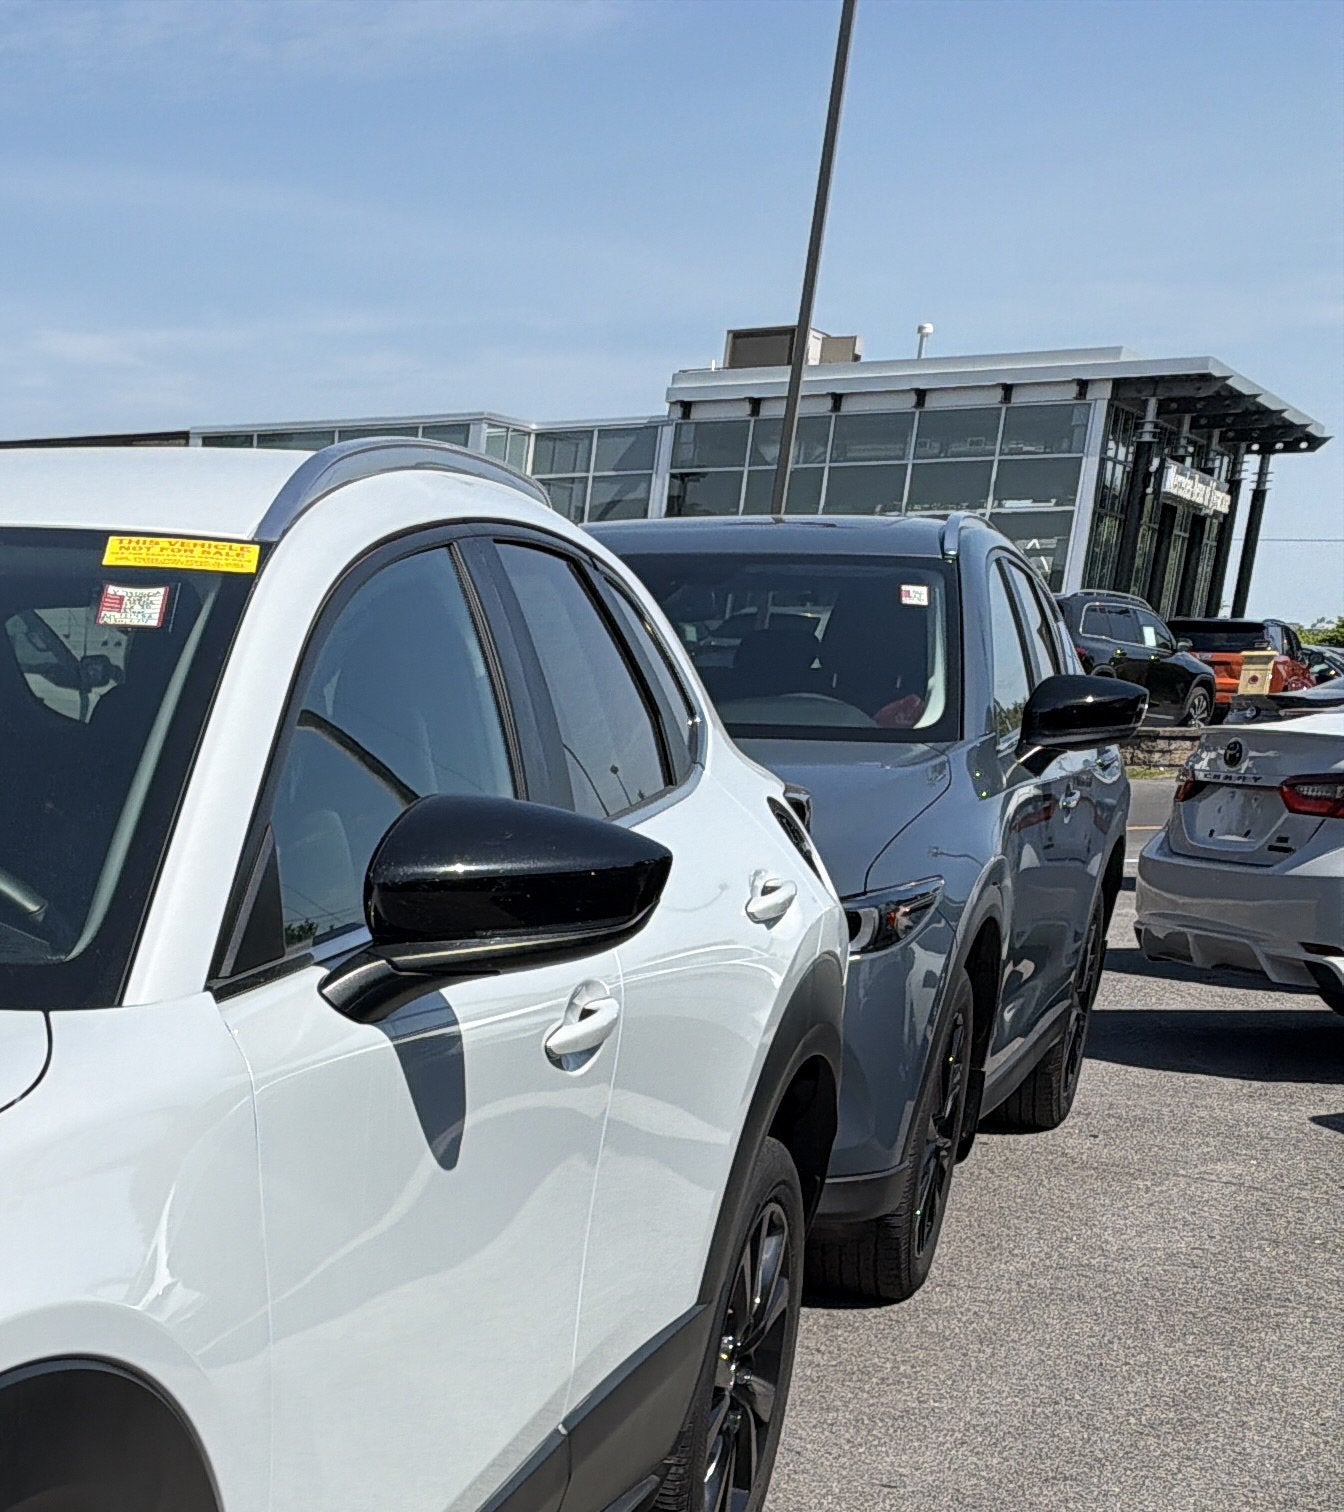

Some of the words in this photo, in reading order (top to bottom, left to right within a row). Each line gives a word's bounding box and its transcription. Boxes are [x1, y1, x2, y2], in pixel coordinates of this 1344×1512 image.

[118, 538, 160, 546] THIS
[168, 540, 252, 552] VEHICLE
[201, 549, 246, 558] SALE
[1204, 772, 1262, 783] CAMRY
